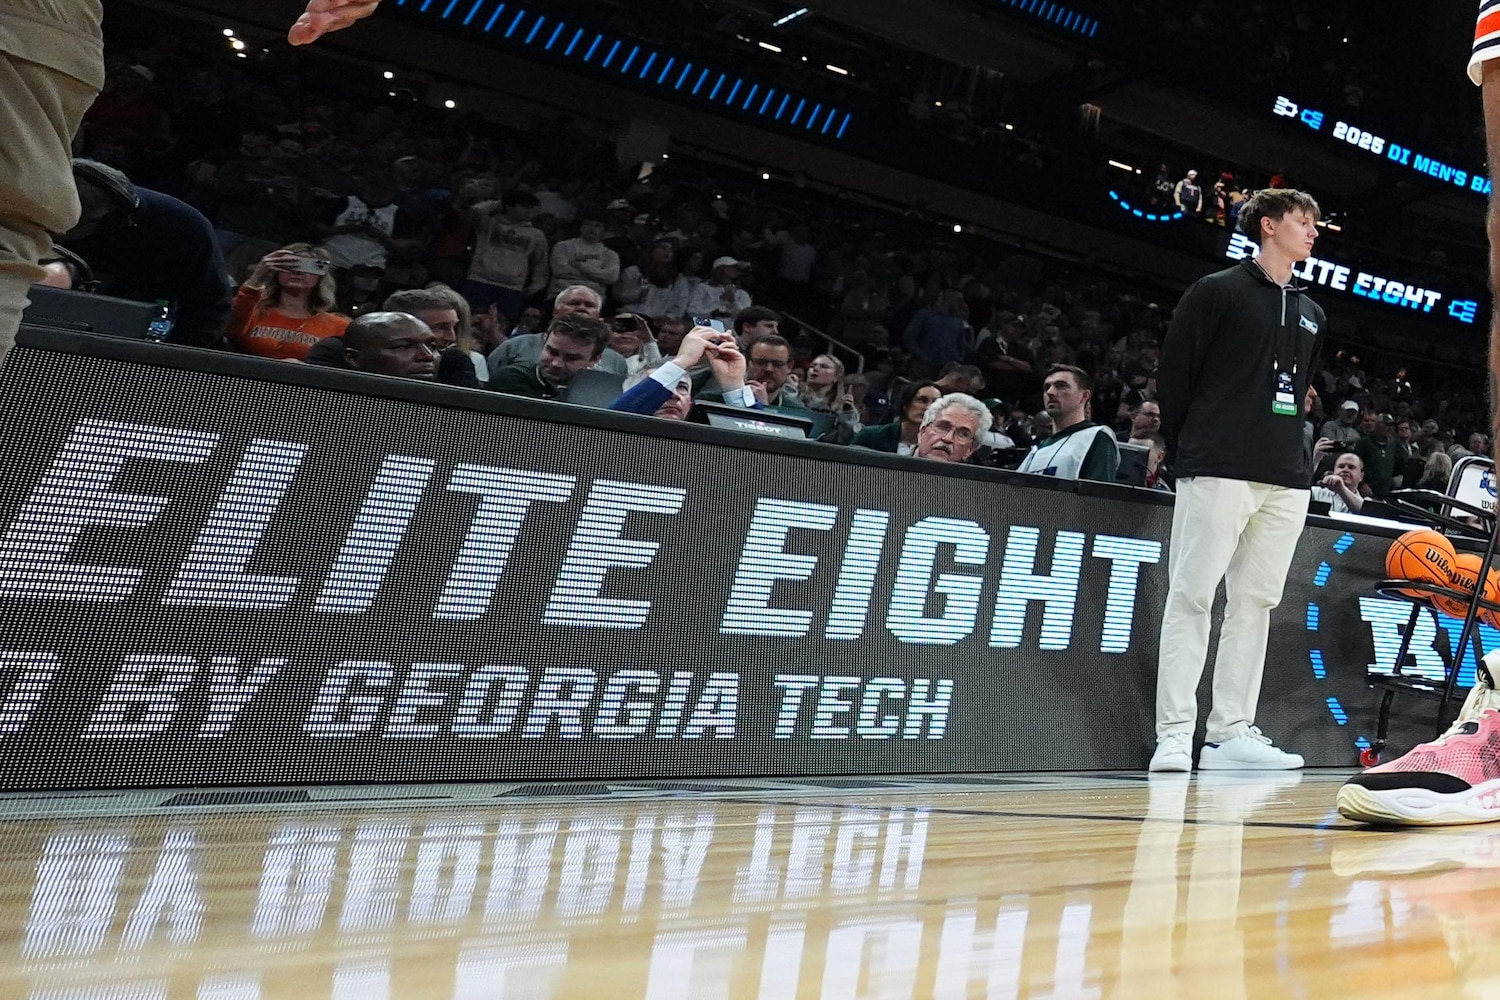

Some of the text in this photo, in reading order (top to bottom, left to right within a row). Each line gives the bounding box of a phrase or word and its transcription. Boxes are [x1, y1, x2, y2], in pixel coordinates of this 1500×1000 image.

[1333, 121, 1385, 155] 2025
[1387, 143, 1411, 166] DI
[1413, 154, 1467, 187] MEN'S
[1291, 257, 1442, 313] LITE EIGHT
[735, 421, 781, 434] TISSOT
[0, 417, 1162, 654] ELITE EIGHT
[80, 655, 288, 739] BY
[302, 660, 740, 739] GEORGIA
[774, 674, 954, 740] TECH
